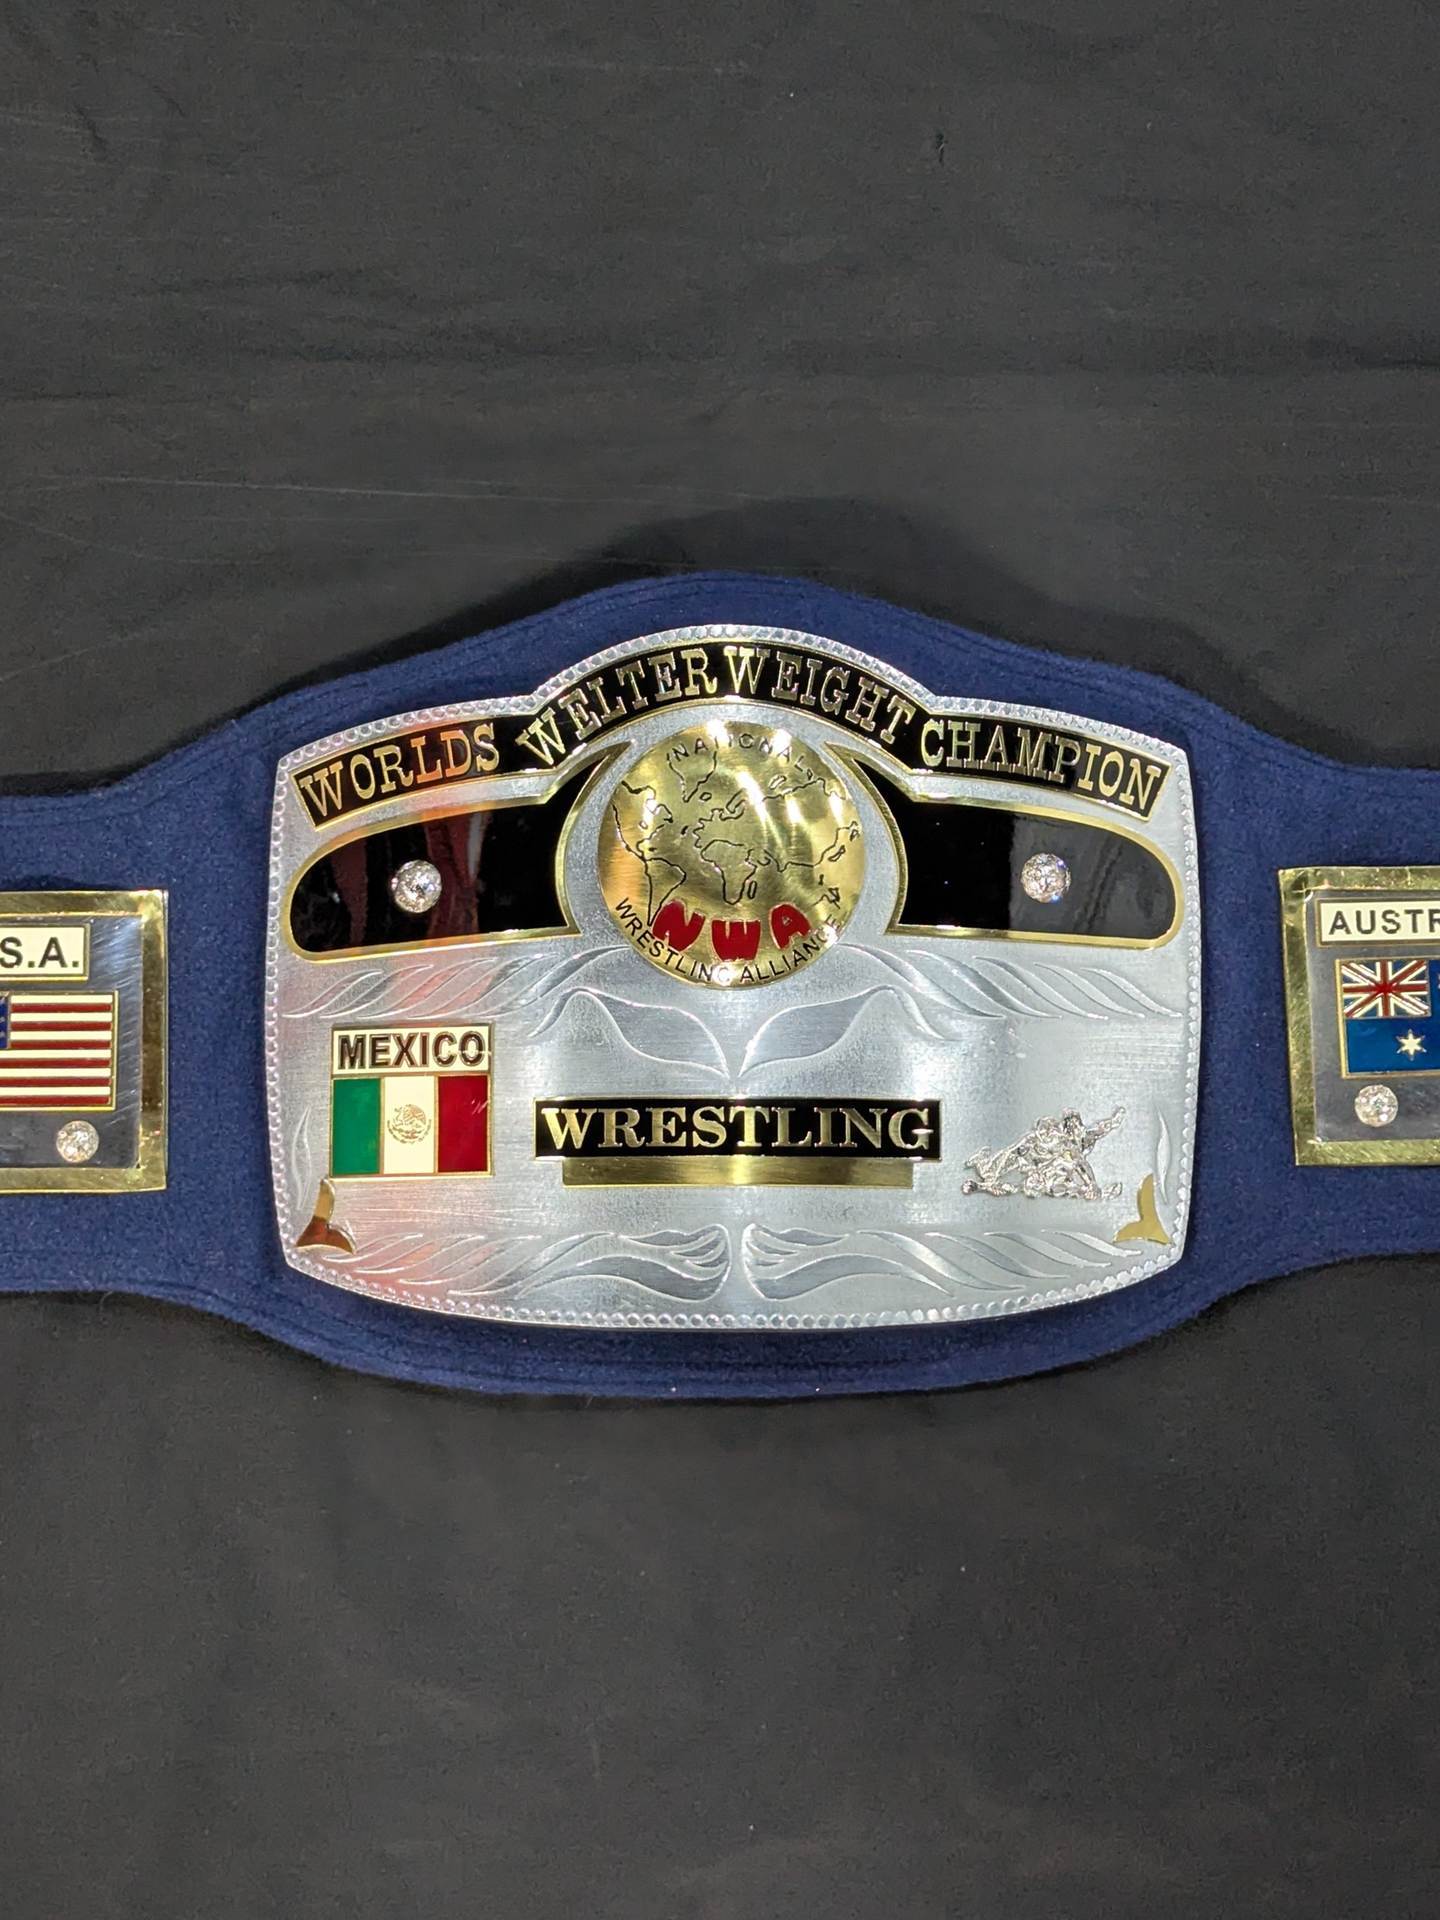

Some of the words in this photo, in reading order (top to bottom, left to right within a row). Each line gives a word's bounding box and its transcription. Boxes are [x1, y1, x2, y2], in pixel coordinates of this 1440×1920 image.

[300, 723, 500, 817] WORLDS
[920, 719, 1161, 811] CHAMPION
[651, 899, 812, 963] NWA
[337, 1030, 486, 1070] MEXICO
[541, 1105, 933, 1151] WRESTLING
